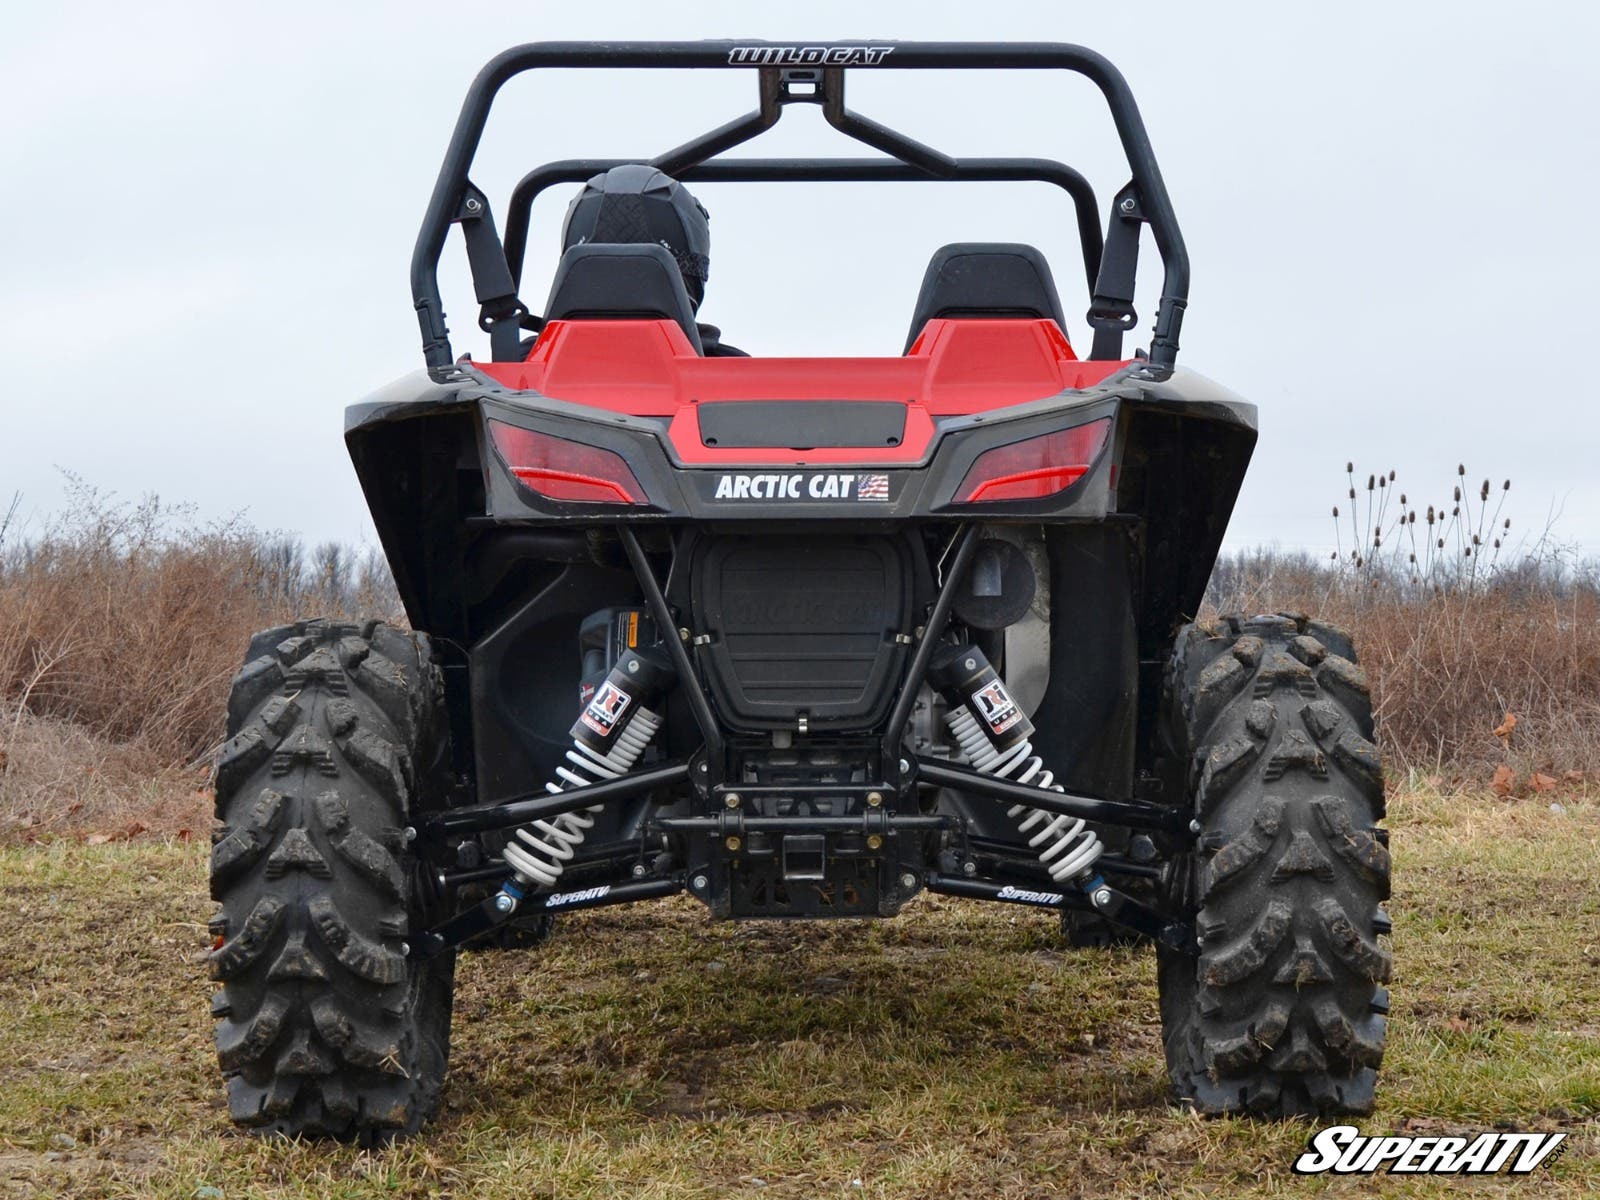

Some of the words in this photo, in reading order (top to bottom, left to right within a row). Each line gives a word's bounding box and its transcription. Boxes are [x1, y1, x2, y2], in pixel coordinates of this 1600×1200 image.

[728, 47, 895, 65] WILDCAT
[715, 474, 802, 498] ARCTIC
[808, 474, 854, 498] CAT
